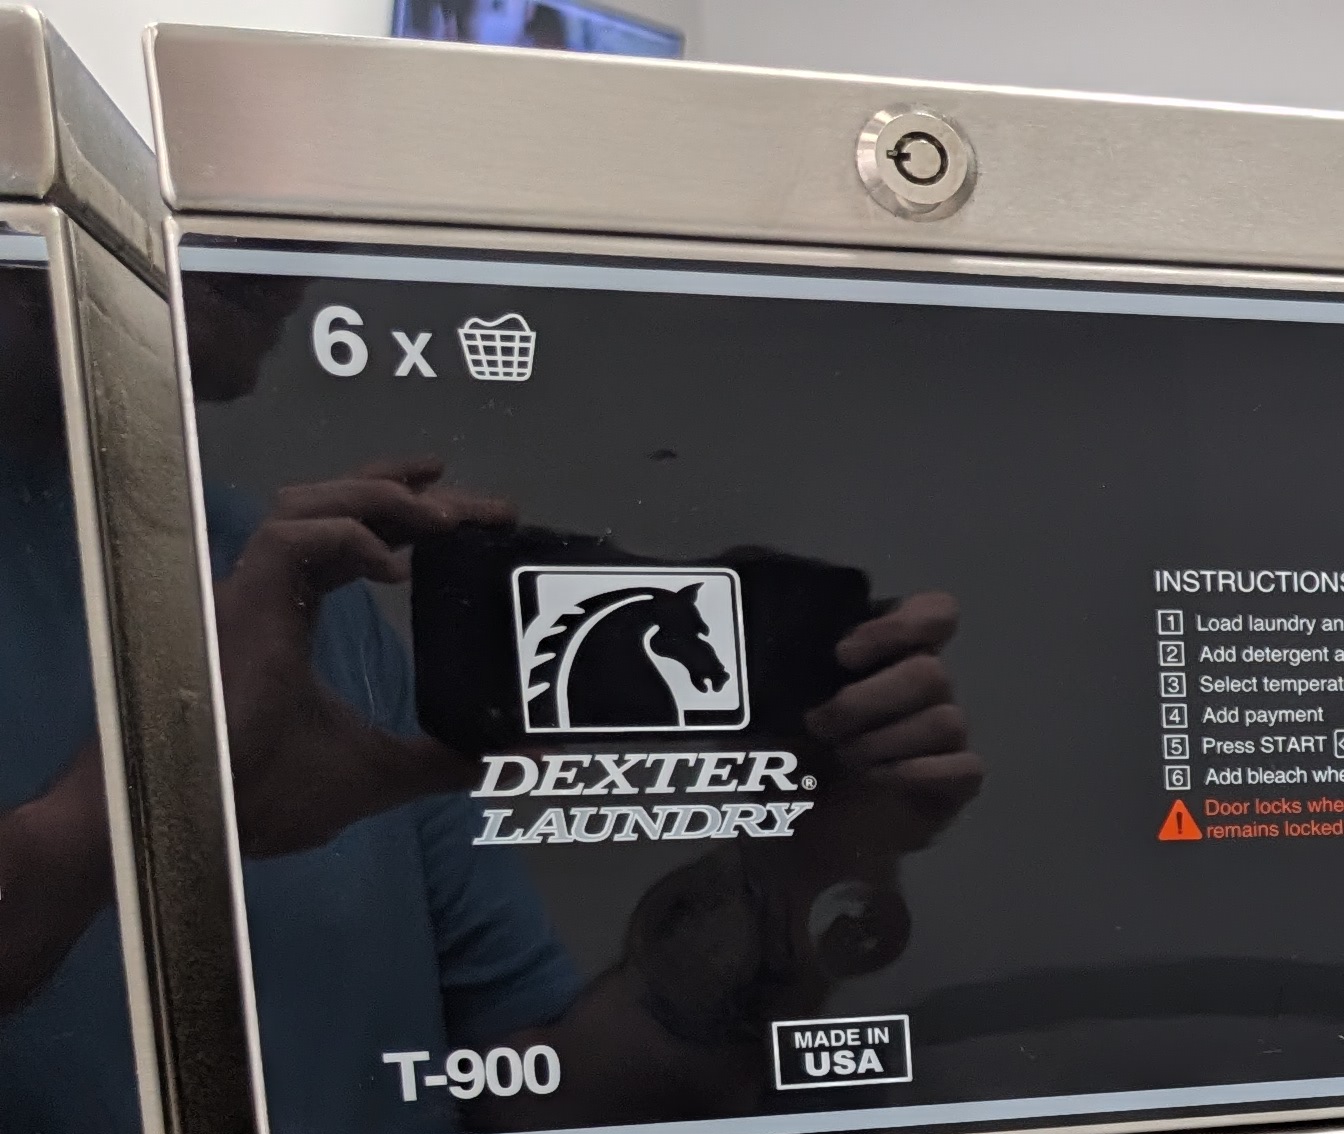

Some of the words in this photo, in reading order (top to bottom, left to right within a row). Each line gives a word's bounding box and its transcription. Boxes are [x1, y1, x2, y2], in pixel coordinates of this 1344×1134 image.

[311, 304, 369, 378] 6
[391, 329, 438, 378] x
[1196, 615, 1243, 633] Load
[1248, 614, 1316, 636] laundry
[1200, 646, 1236, 663] Add
[1241, 646, 1329, 666] detergent
[1200, 676, 1258, 694] Select
[1202, 708, 1239, 724] Add
[1245, 707, 1324, 726] payment
[1202, 737, 1255, 754] Press
[1260, 736, 1327, 753] START
[1205, 769, 1242, 786] Add
[1247, 768, 1307, 785] bleach
[1205, 799, 1250, 817] Door
[1255, 797, 1302, 815] locks
[473, 801, 814, 846] LAUNDRY
[1206, 821, 1279, 839] remains
[1284, 818, 1343, 837] locked
[793, 1027, 862, 1050] MADE
[866, 1026, 890, 1046] IN
[381, 1043, 561, 1103] T-900
[804, 1048, 884, 1077] USA
